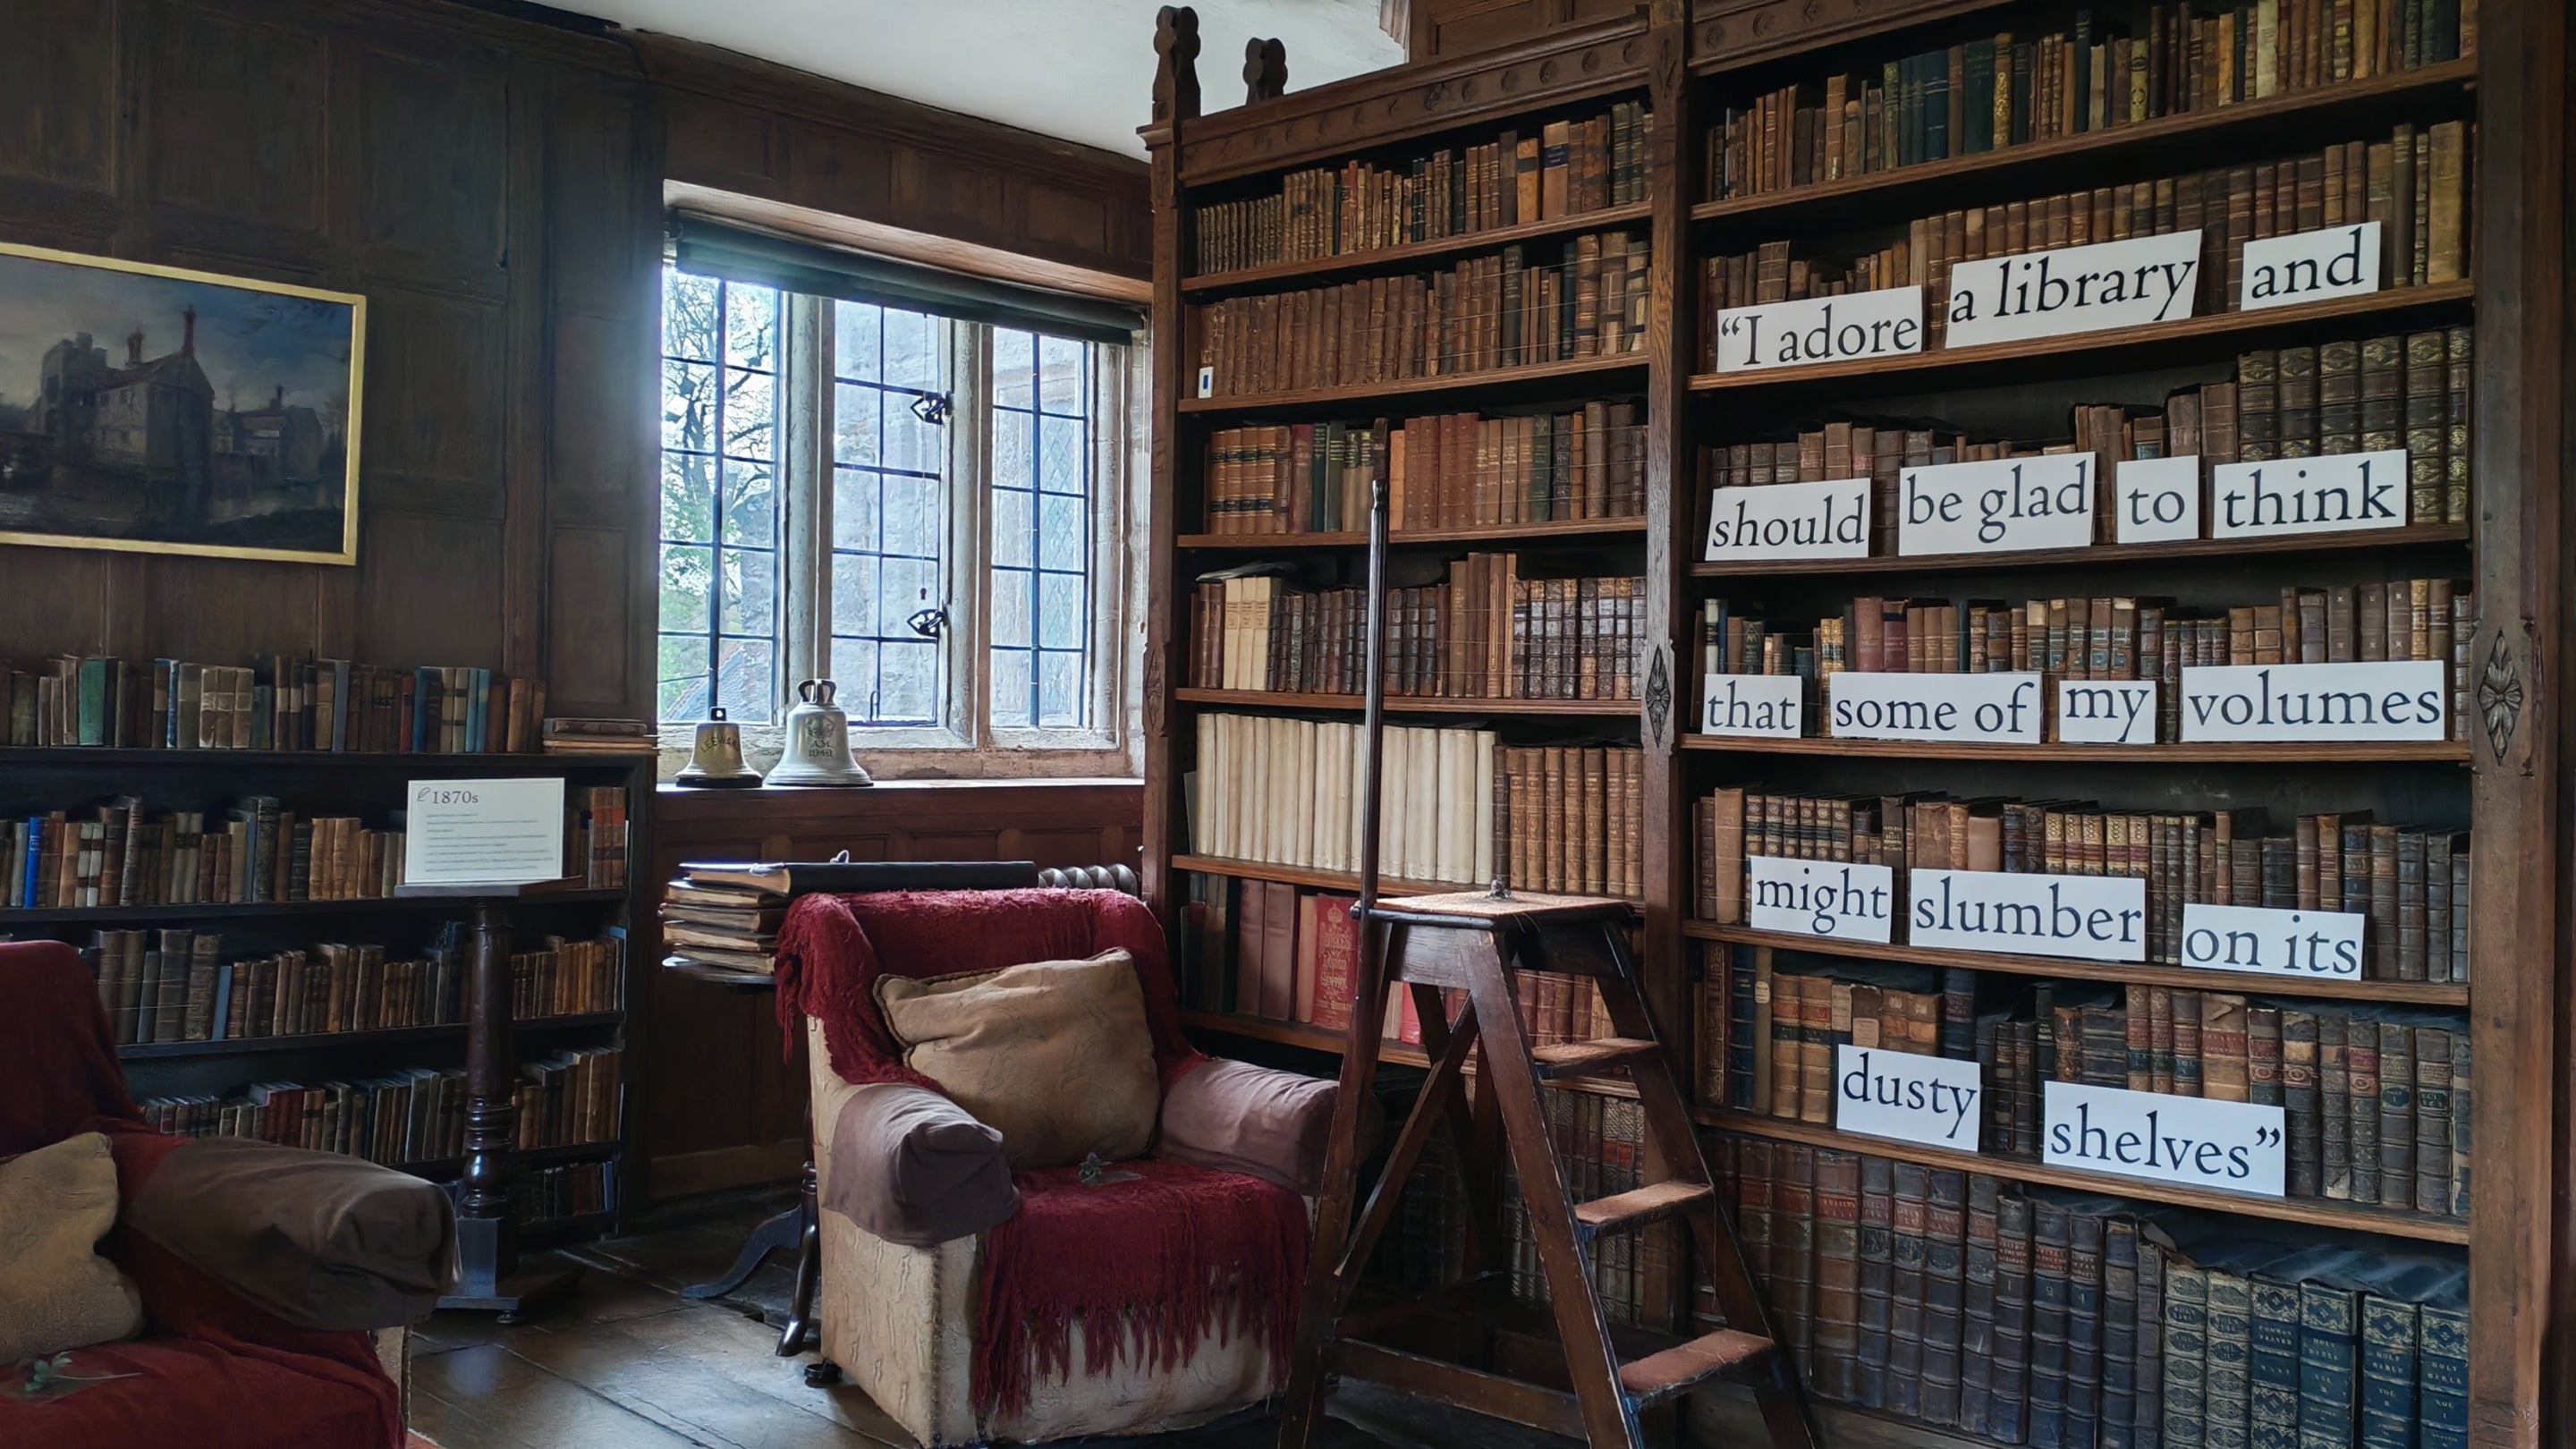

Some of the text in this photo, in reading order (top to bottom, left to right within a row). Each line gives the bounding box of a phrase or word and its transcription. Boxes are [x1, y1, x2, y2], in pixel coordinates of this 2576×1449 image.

[1951, 255, 2198, 324] a library
[2251, 225, 2365, 300] and
[1778, 302, 1919, 363] adore
[1712, 493, 1865, 547] should
[1906, 459, 2089, 544] be glad
[2127, 487, 2185, 526] to
[2223, 460, 2397, 529] think
[1707, 679, 1796, 731] that
[1835, 681, 2035, 733] some of
[2065, 687, 2150, 742] my
[2188, 669, 2440, 726] volumes
[433, 790, 479, 804] 1870s
[1756, 867, 1888, 935] might
[1915, 876, 2142, 943] slumber
[2185, 914, 2357, 974] on its
[1843, 1051, 1978, 1140] dusty
[2051, 1102, 2281, 1179] shelves”
